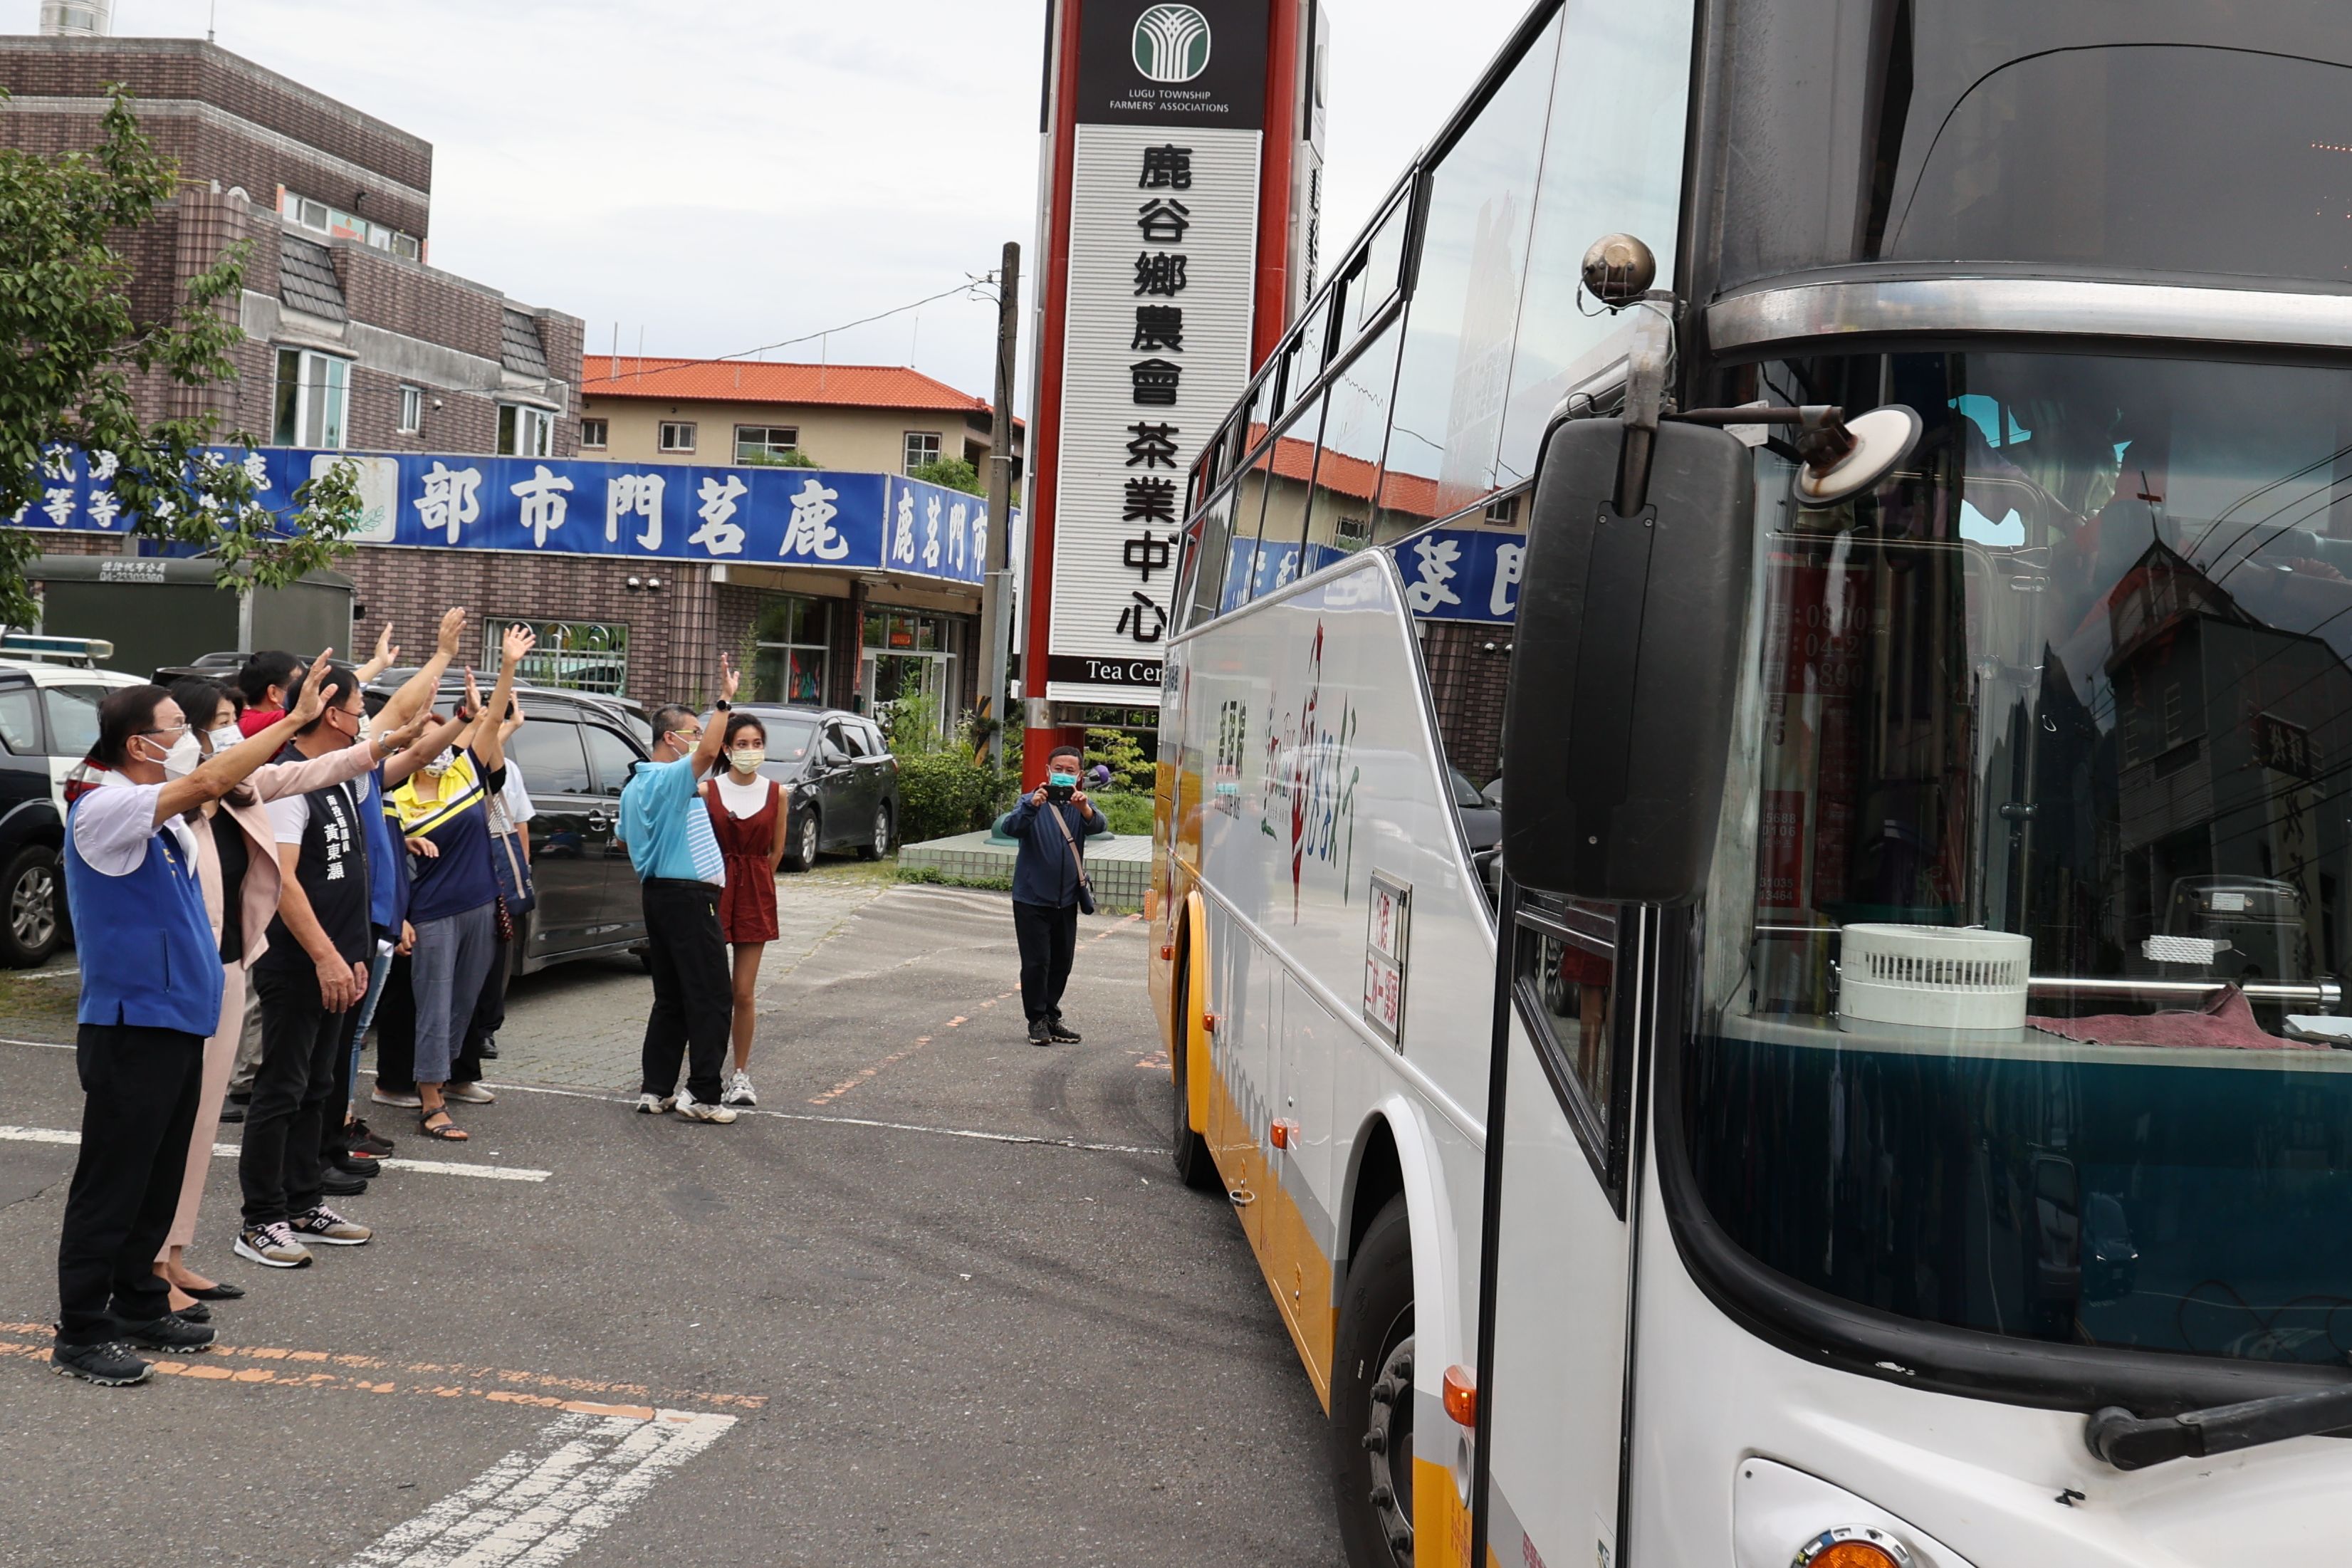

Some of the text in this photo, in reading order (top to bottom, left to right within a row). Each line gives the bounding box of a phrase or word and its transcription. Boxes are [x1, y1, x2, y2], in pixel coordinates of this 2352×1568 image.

[1129, 89, 1211, 100] LUGU TOWNSHIP
[1109, 100, 1229, 113] FARMERS' ASSOCIATIONS
[1116, 143, 1193, 642] 鹿谷鄉農會茶業中心
[1086, 660, 1122, 680] Tea
